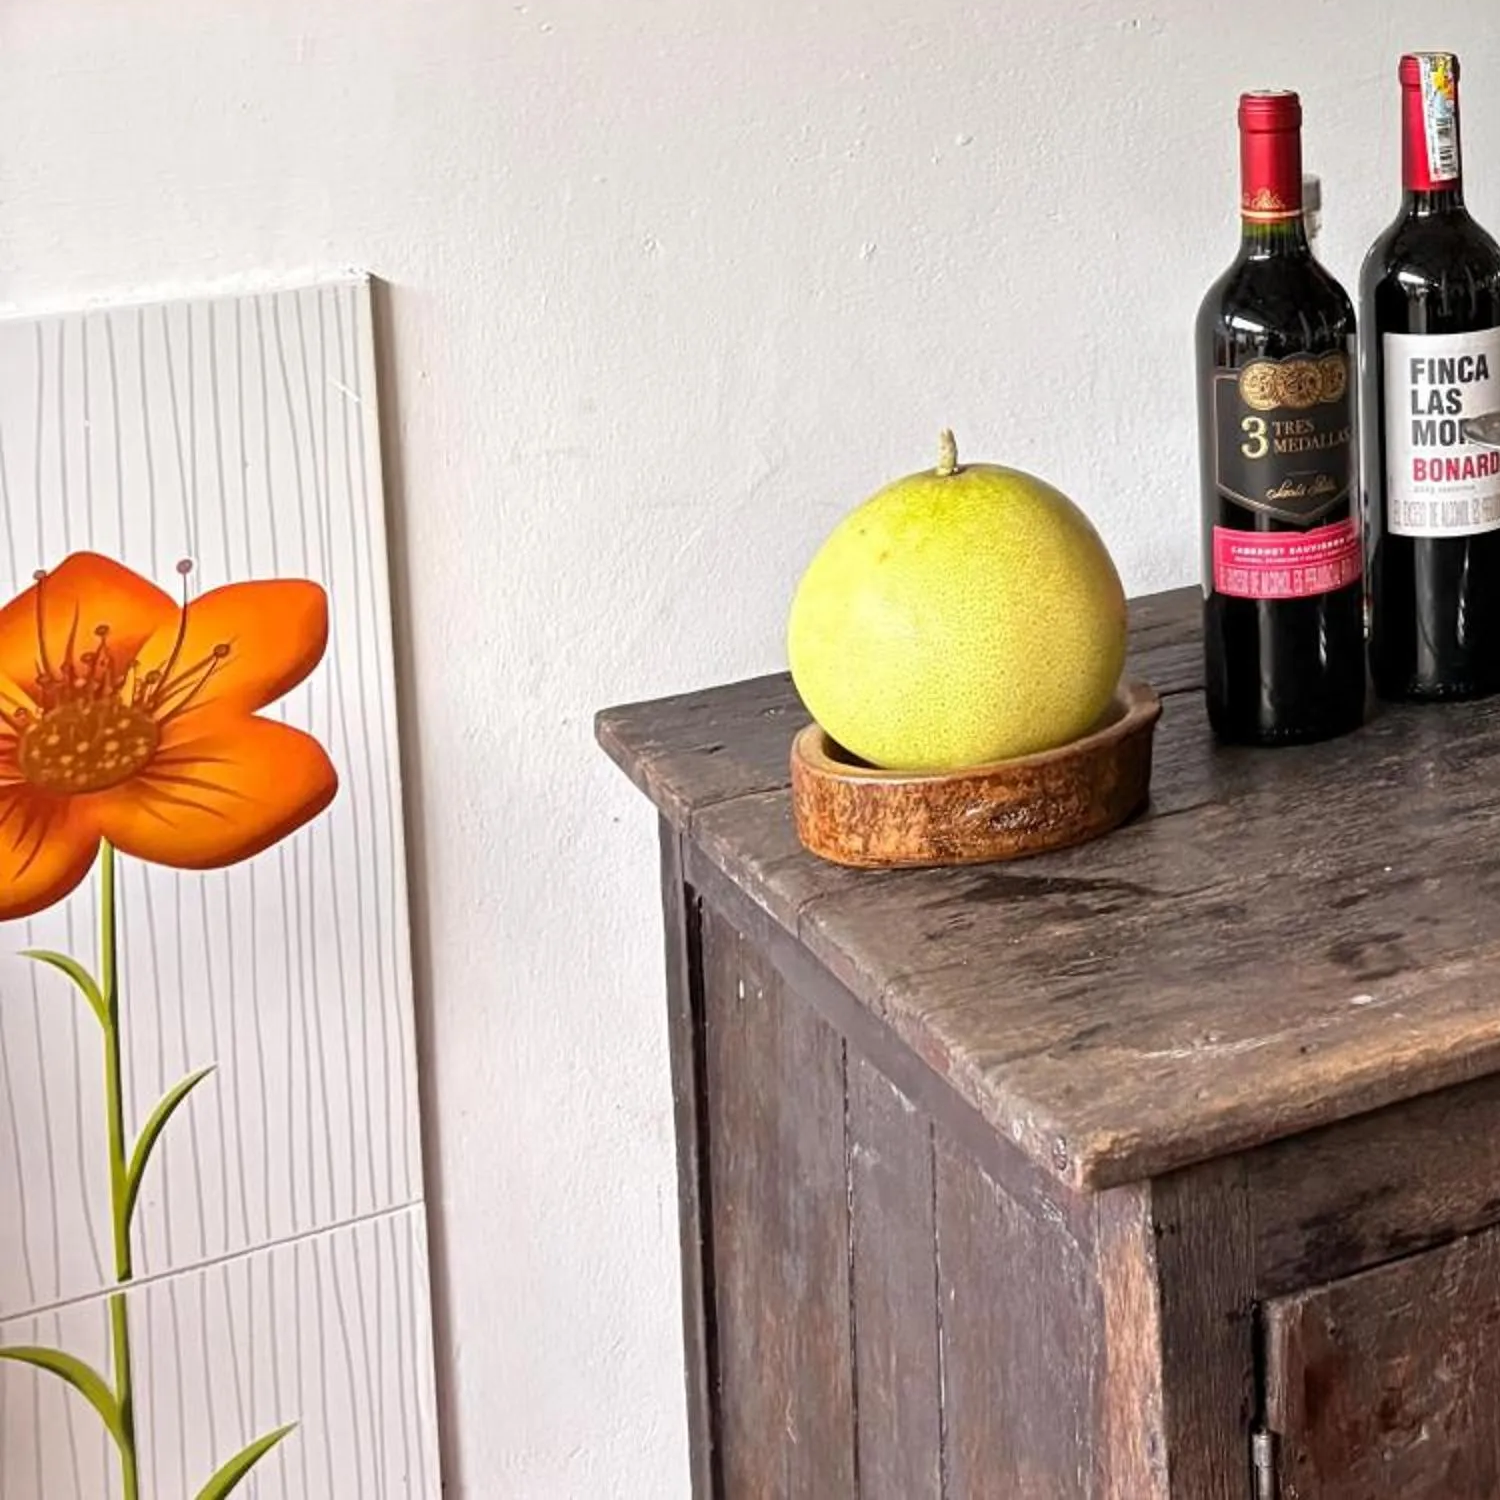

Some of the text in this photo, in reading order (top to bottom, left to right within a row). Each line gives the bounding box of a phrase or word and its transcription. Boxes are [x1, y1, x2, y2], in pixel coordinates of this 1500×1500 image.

[1409, 353, 1490, 385] FINCA
[1410, 388, 1463, 416] LAS
[1240, 415, 1269, 460] 3
[1271, 419, 1316, 436] TRES
[1273, 426, 1352, 455] MEDALLAS
